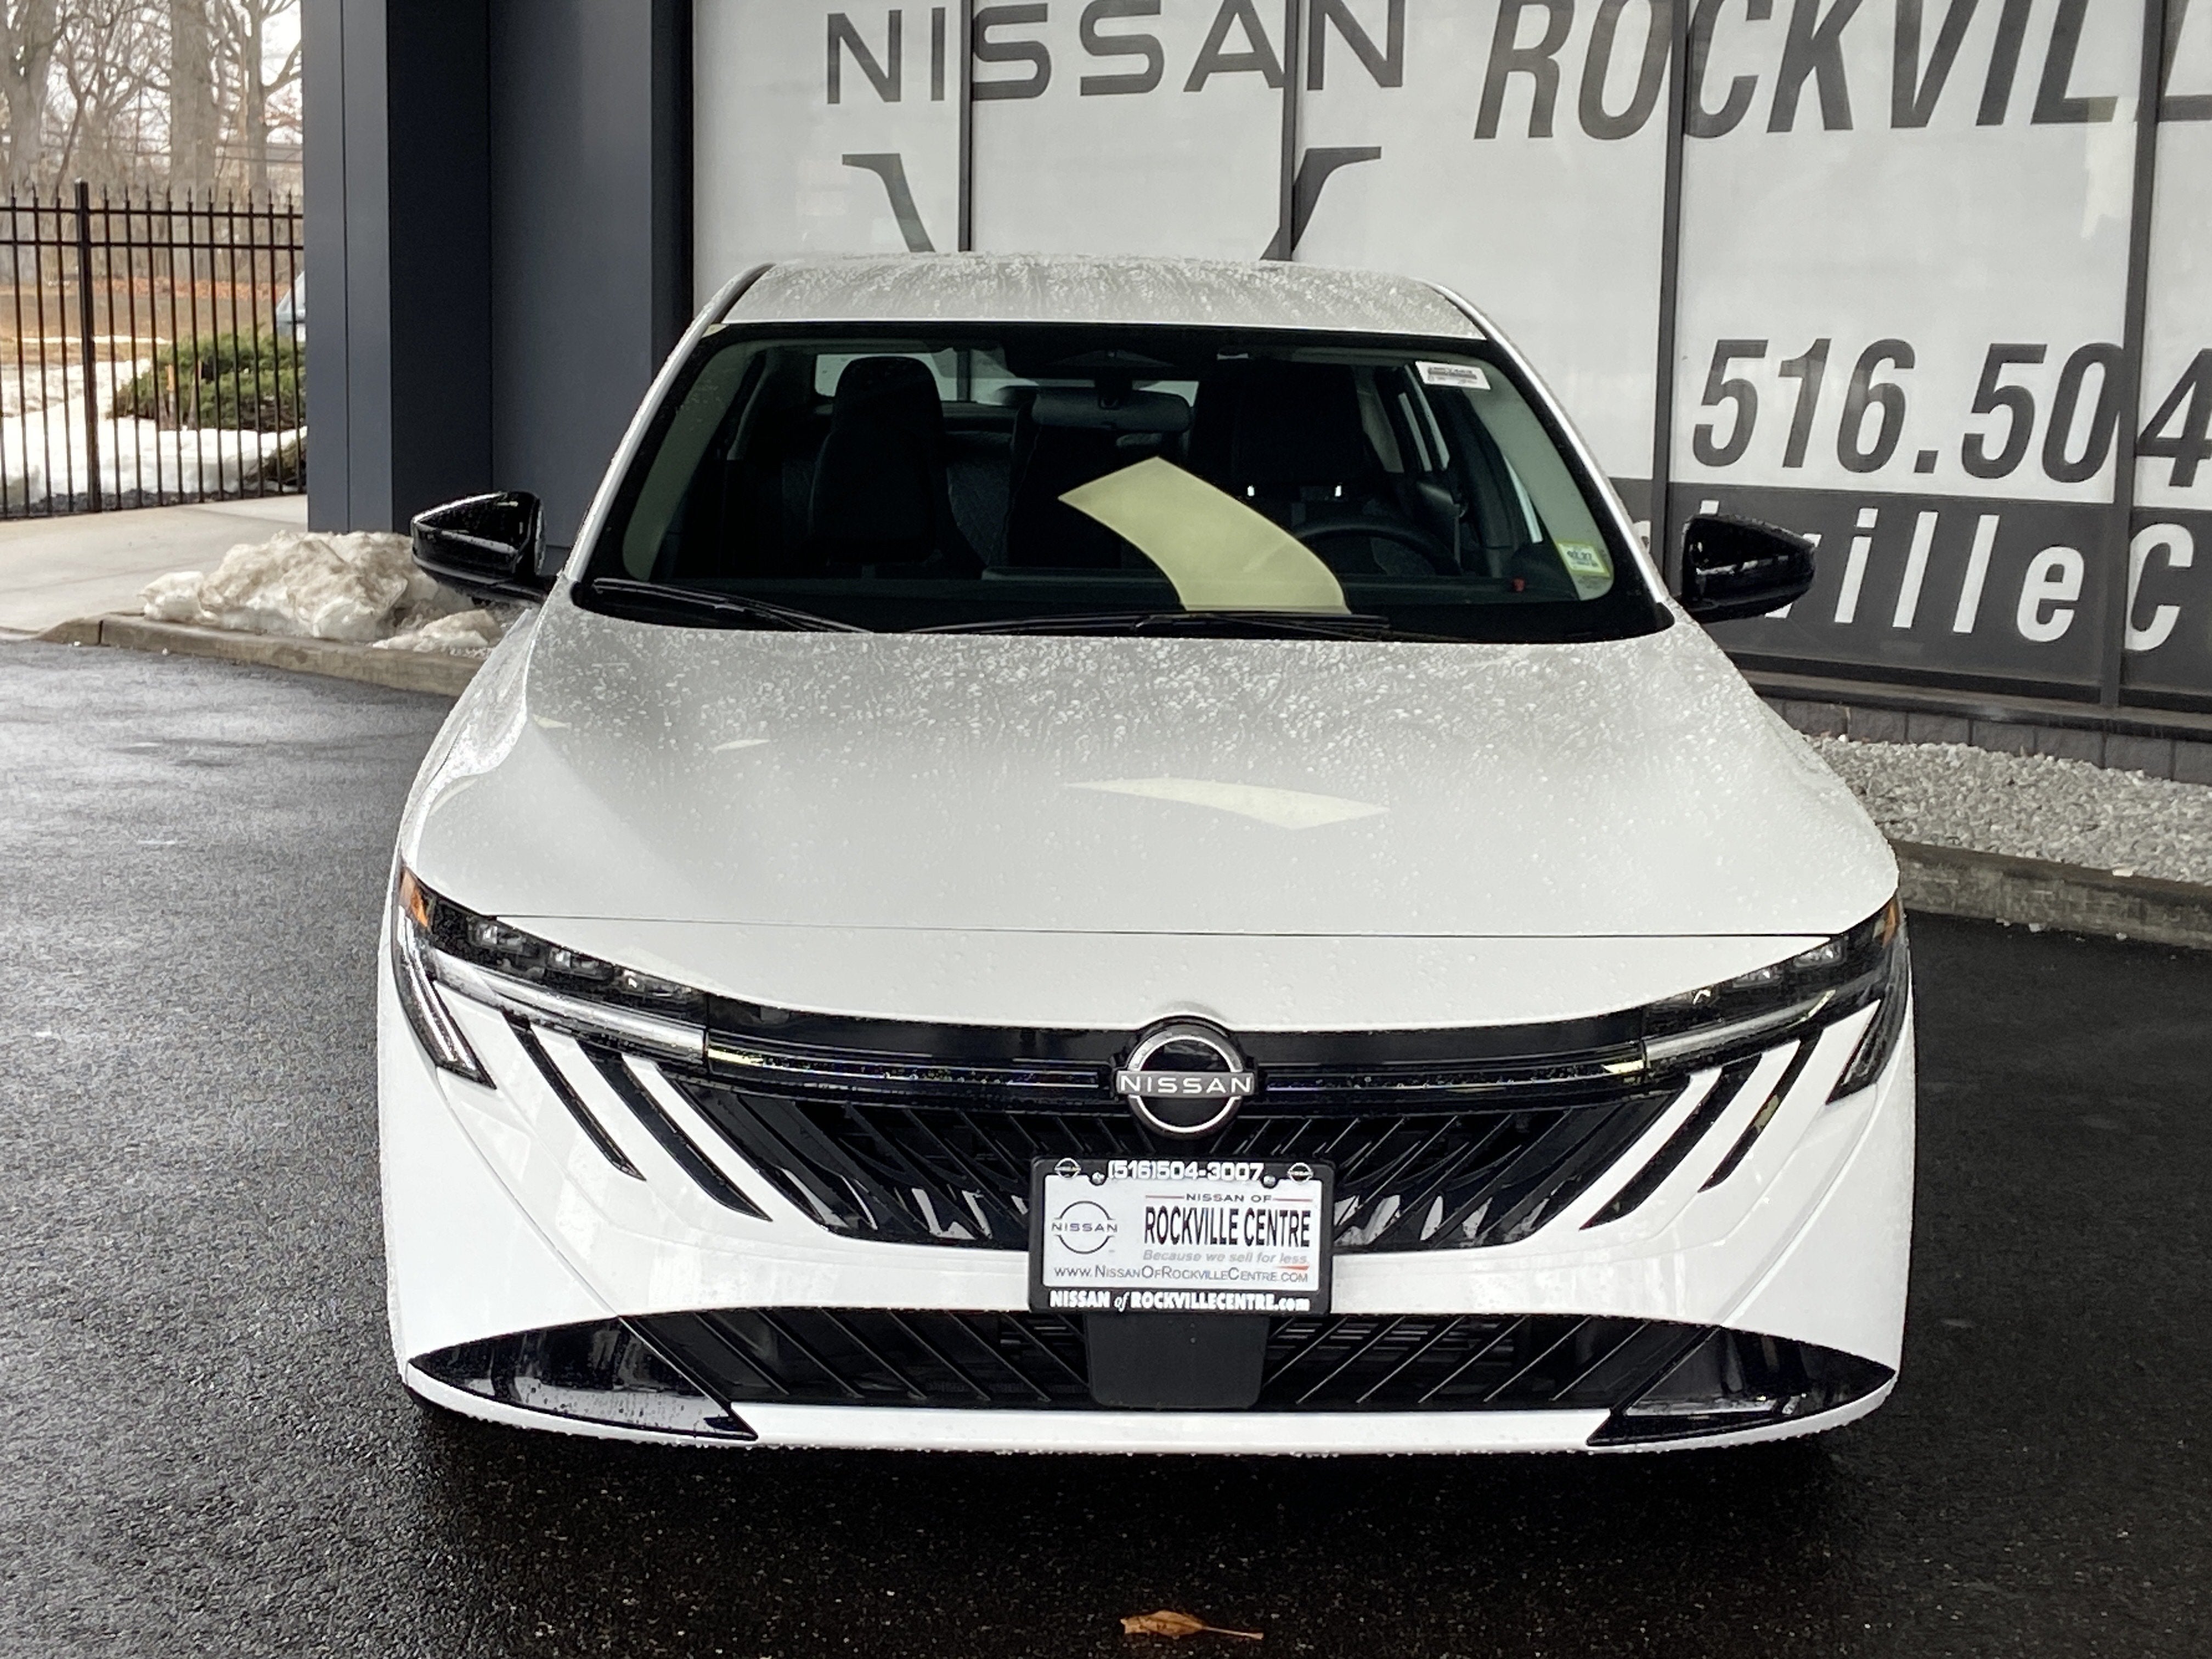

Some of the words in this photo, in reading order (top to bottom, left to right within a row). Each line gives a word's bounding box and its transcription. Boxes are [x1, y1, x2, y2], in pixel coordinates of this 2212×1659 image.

[827, 0, 1404, 105] NISSAN
[1691, 337, 2212, 488] 516.504
[1633, 500, 2195, 652] illeC
[1120, 1075, 1251, 1094] NISSAN
[1108, 1160, 1265, 1181] (516)504-3007
[1186, 1193, 1245, 1203] NISSAN
[1250, 1194, 1272, 1203] OF
[1051, 1222, 1118, 1233] NISSAN
[1144, 1205, 1239, 1245] ROCKVILLE
[1243, 1207, 1311, 1248] CENTRE
[1143, 1249, 1202, 1261] Because
[1206, 1254, 1226, 1262] we
[1229, 1252, 1254, 1262] sell
[1256, 1252, 1277, 1263] for
[1279, 1252, 1307, 1264] less
[1049, 1290, 1111, 1308] NISSAN
[1113, 1291, 1130, 1312] of
[1130, 1291, 1311, 1311] ROCKVILLECENTRE.com
